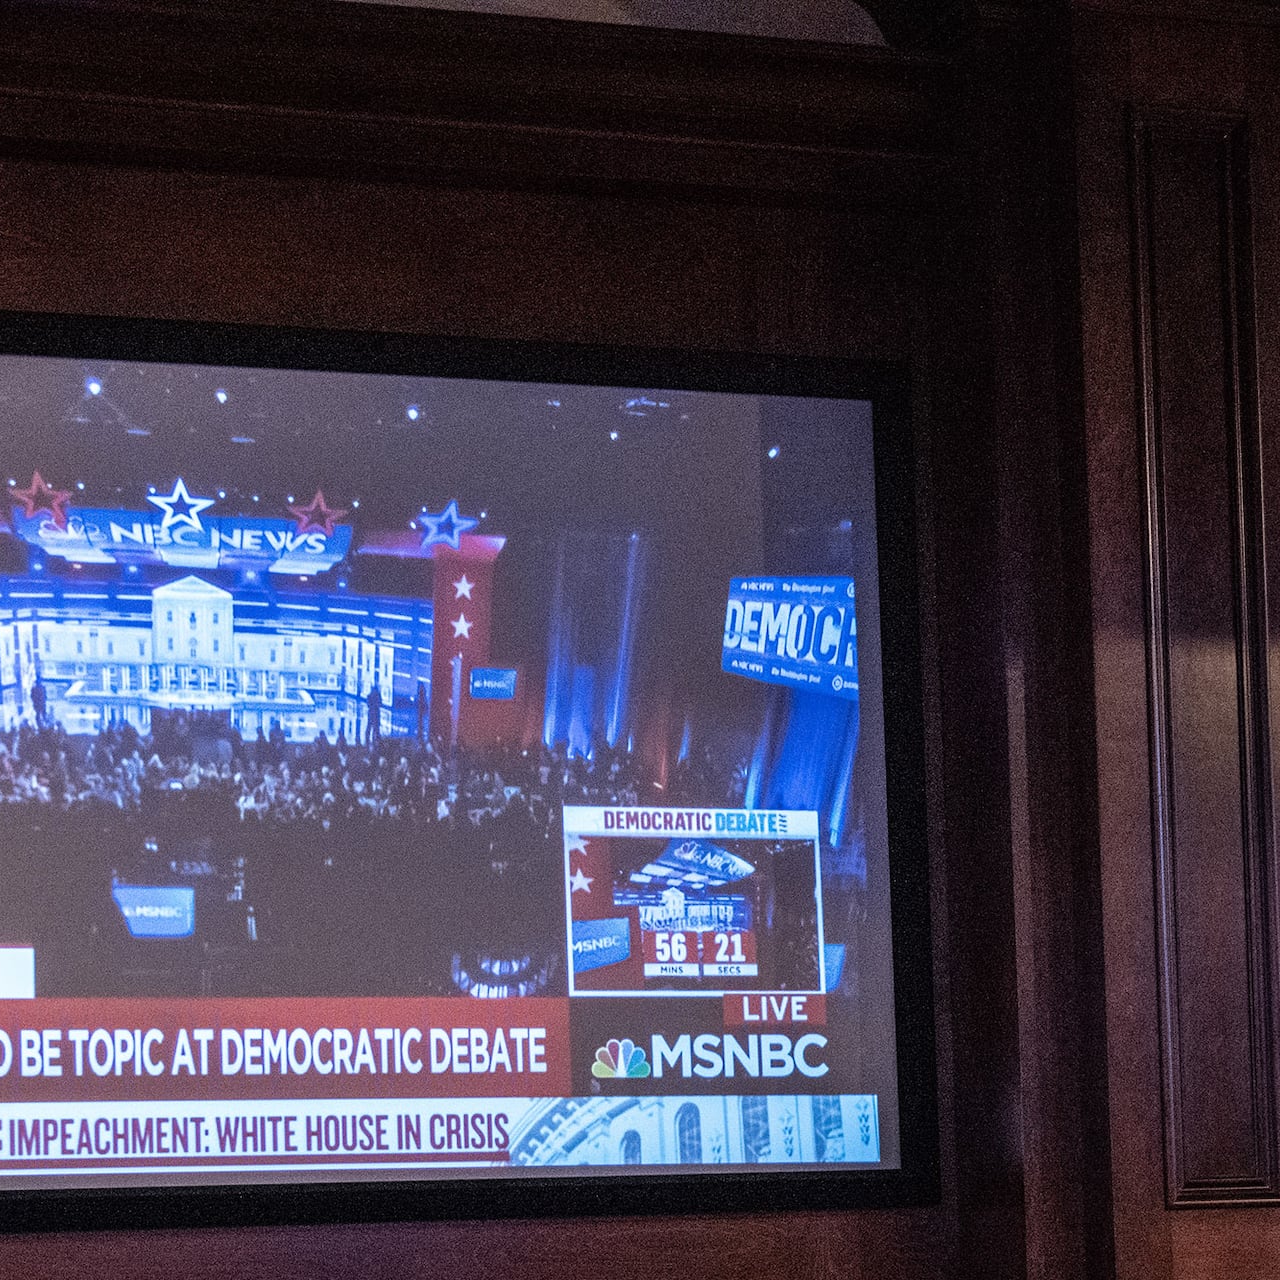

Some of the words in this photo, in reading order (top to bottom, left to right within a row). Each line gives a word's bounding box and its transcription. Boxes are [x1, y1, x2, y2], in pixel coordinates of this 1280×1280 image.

[110, 521, 199, 548] NBC
[211, 527, 327, 554] NEWS
[604, 811, 712, 831] DEMOCRATIC
[715, 812, 777, 833] DEBATE
[655, 932, 687, 962] 56
[714, 932, 746, 962] 21
[660, 966, 684, 974] MINS
[717, 966, 741, 974] SECS
[743, 996, 808, 1021] LIVE
[21, 1029, 63, 1077] BE
[68, 1028, 165, 1077] TOPIC
[171, 1028, 214, 1076] AT
[221, 1027, 423, 1075] DEMOCRATIC
[430, 1027, 547, 1073] DEBATE
[651, 1033, 829, 1078] MSNBC
[9, 1117, 209, 1156] IMPEACHMENT:
[216, 1116, 297, 1152] WHITE
[306, 1114, 389, 1151] HOUSE
[397, 1114, 421, 1150] IN
[429, 1113, 510, 1149] CRISIS
